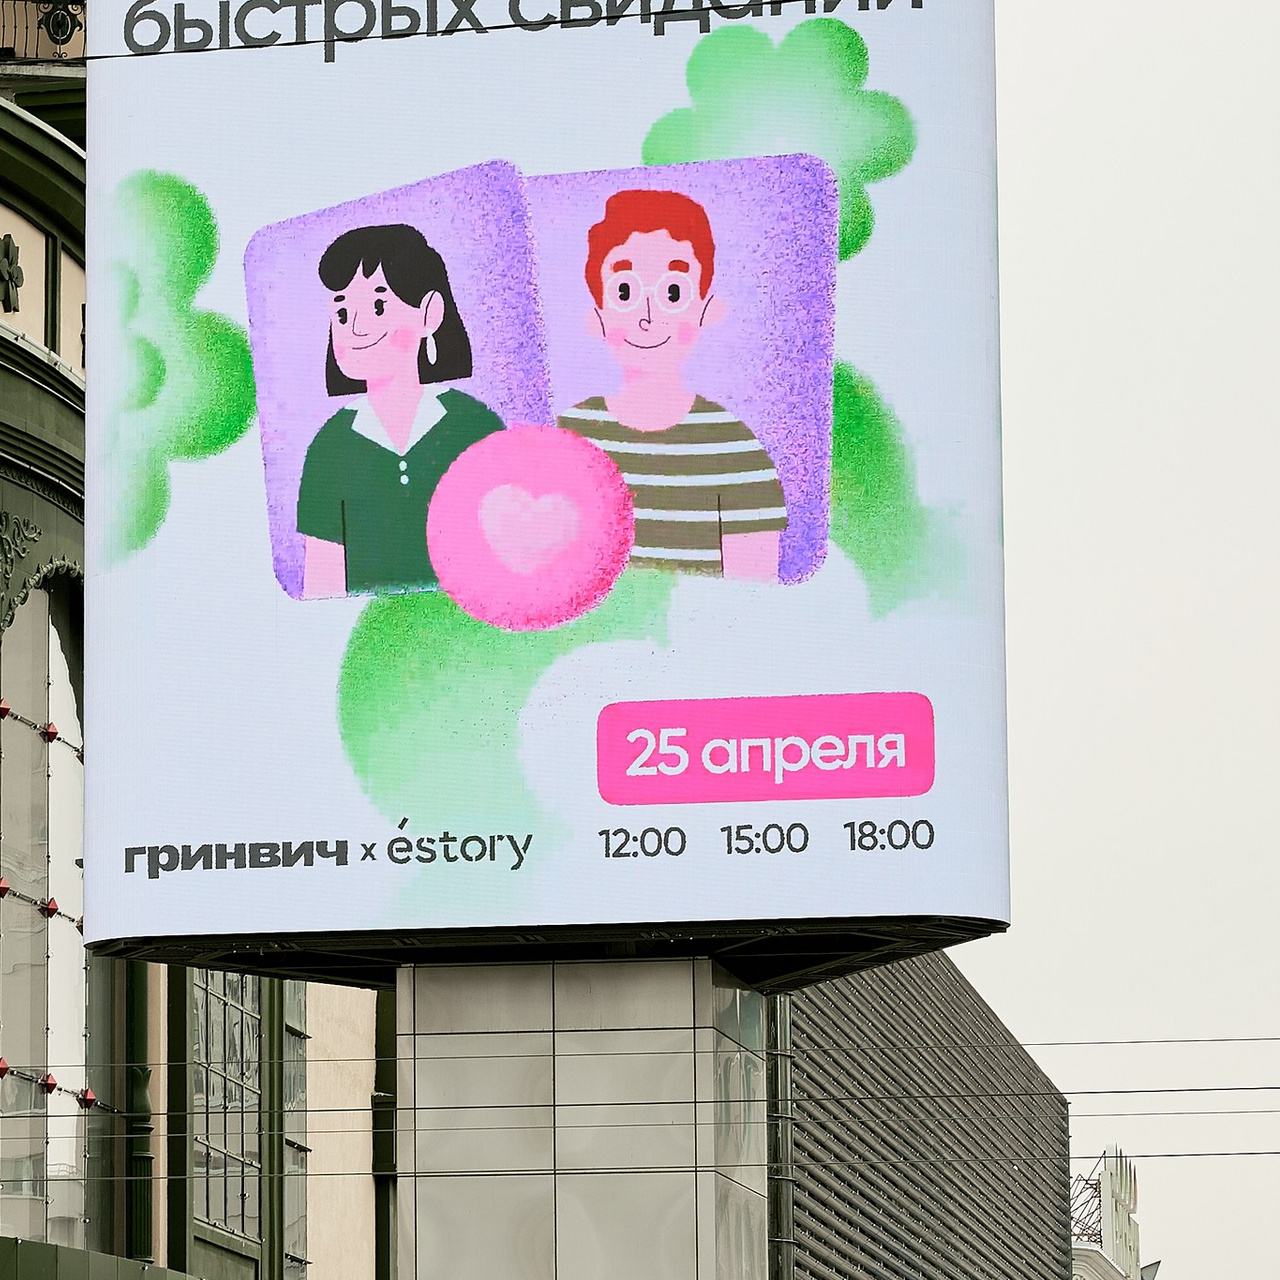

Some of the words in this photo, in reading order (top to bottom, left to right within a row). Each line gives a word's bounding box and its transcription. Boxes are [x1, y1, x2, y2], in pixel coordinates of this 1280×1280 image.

[626, 727, 690, 777] 25
[701, 727, 906, 785] апреля
[598, 826, 687, 858] 12:00
[720, 822, 810, 856] 15:00
[843, 819, 935, 852] 18:00
[124, 839, 349, 880] гринвич
